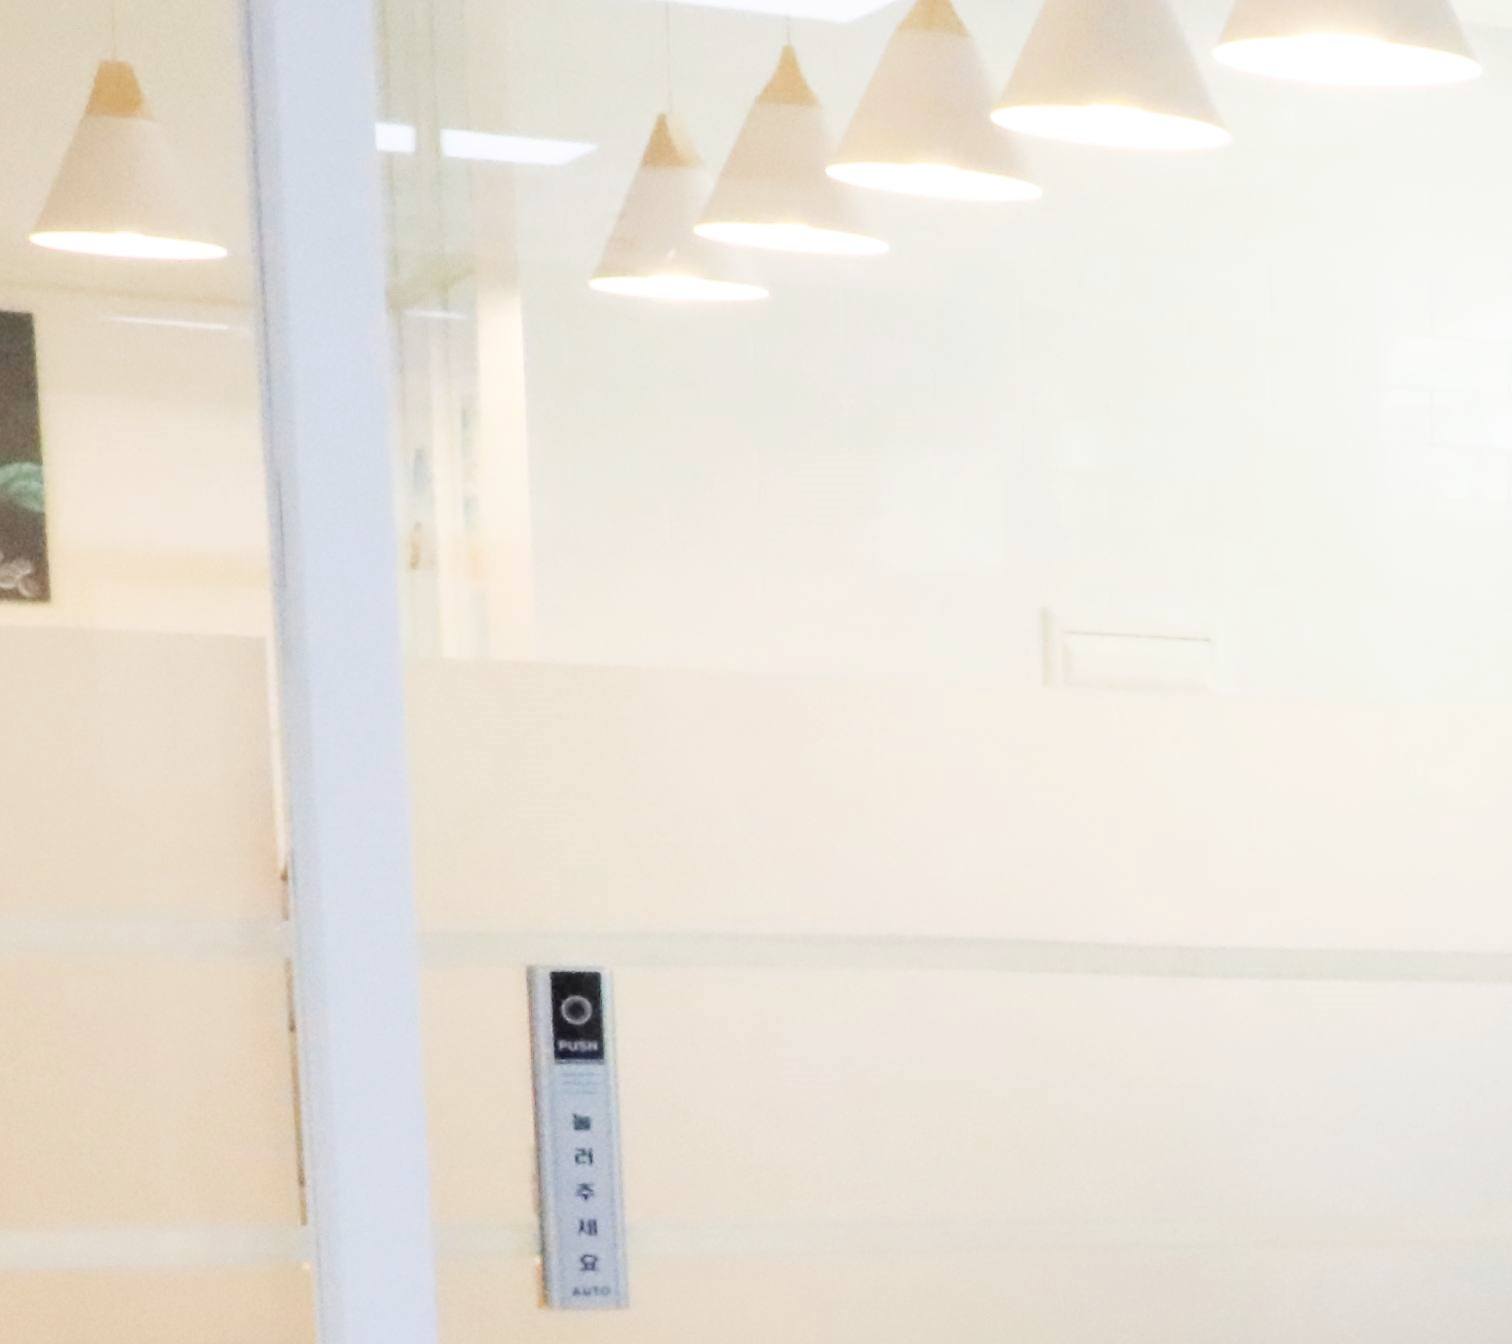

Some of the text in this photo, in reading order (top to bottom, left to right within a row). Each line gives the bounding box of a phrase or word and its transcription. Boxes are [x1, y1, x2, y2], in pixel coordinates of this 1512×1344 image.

[558, 1040, 599, 1052] PUSH
[573, 1114, 599, 1272] 눌러주세요
[572, 1285, 612, 1297] AUTO
